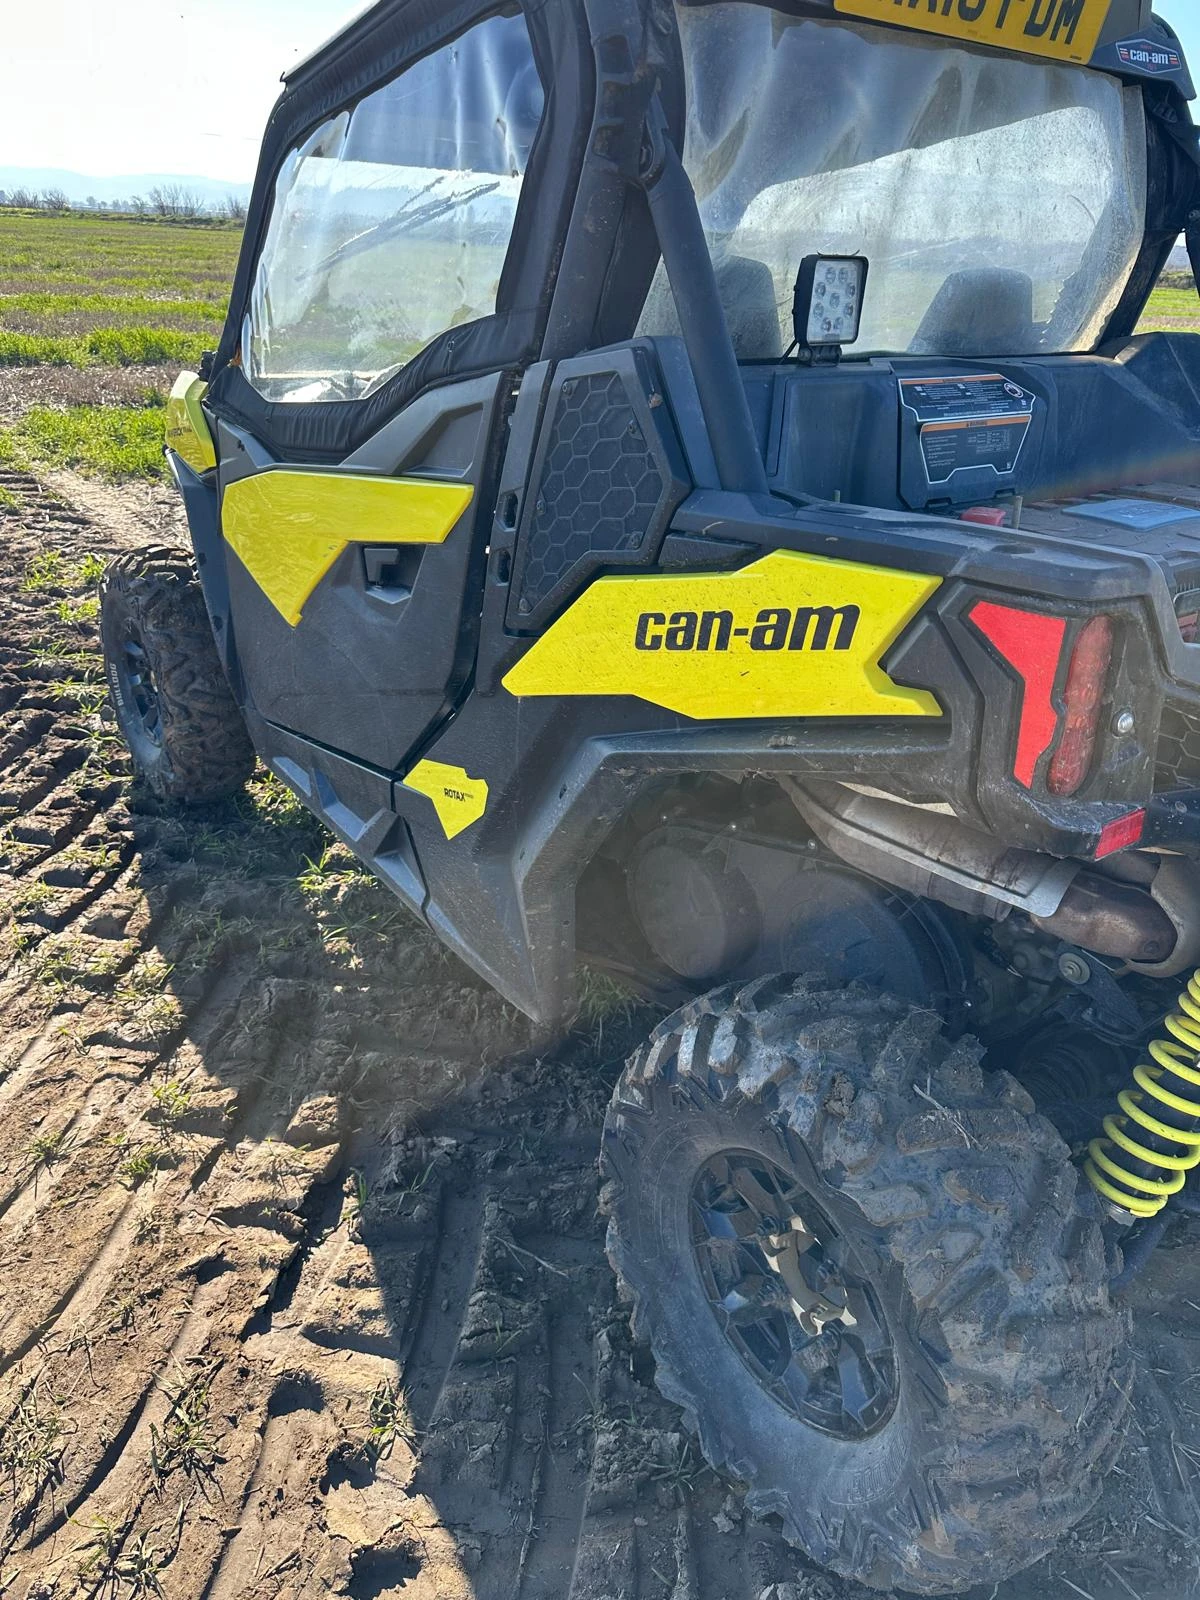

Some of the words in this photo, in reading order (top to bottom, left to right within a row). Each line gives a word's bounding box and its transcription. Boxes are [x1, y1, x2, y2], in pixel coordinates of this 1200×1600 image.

[1130, 49, 1169, 64] can-am
[634, 604, 861, 651] can-am
[110, 663, 124, 706] BULLDOG
[443, 787, 466, 801] ROTAX
